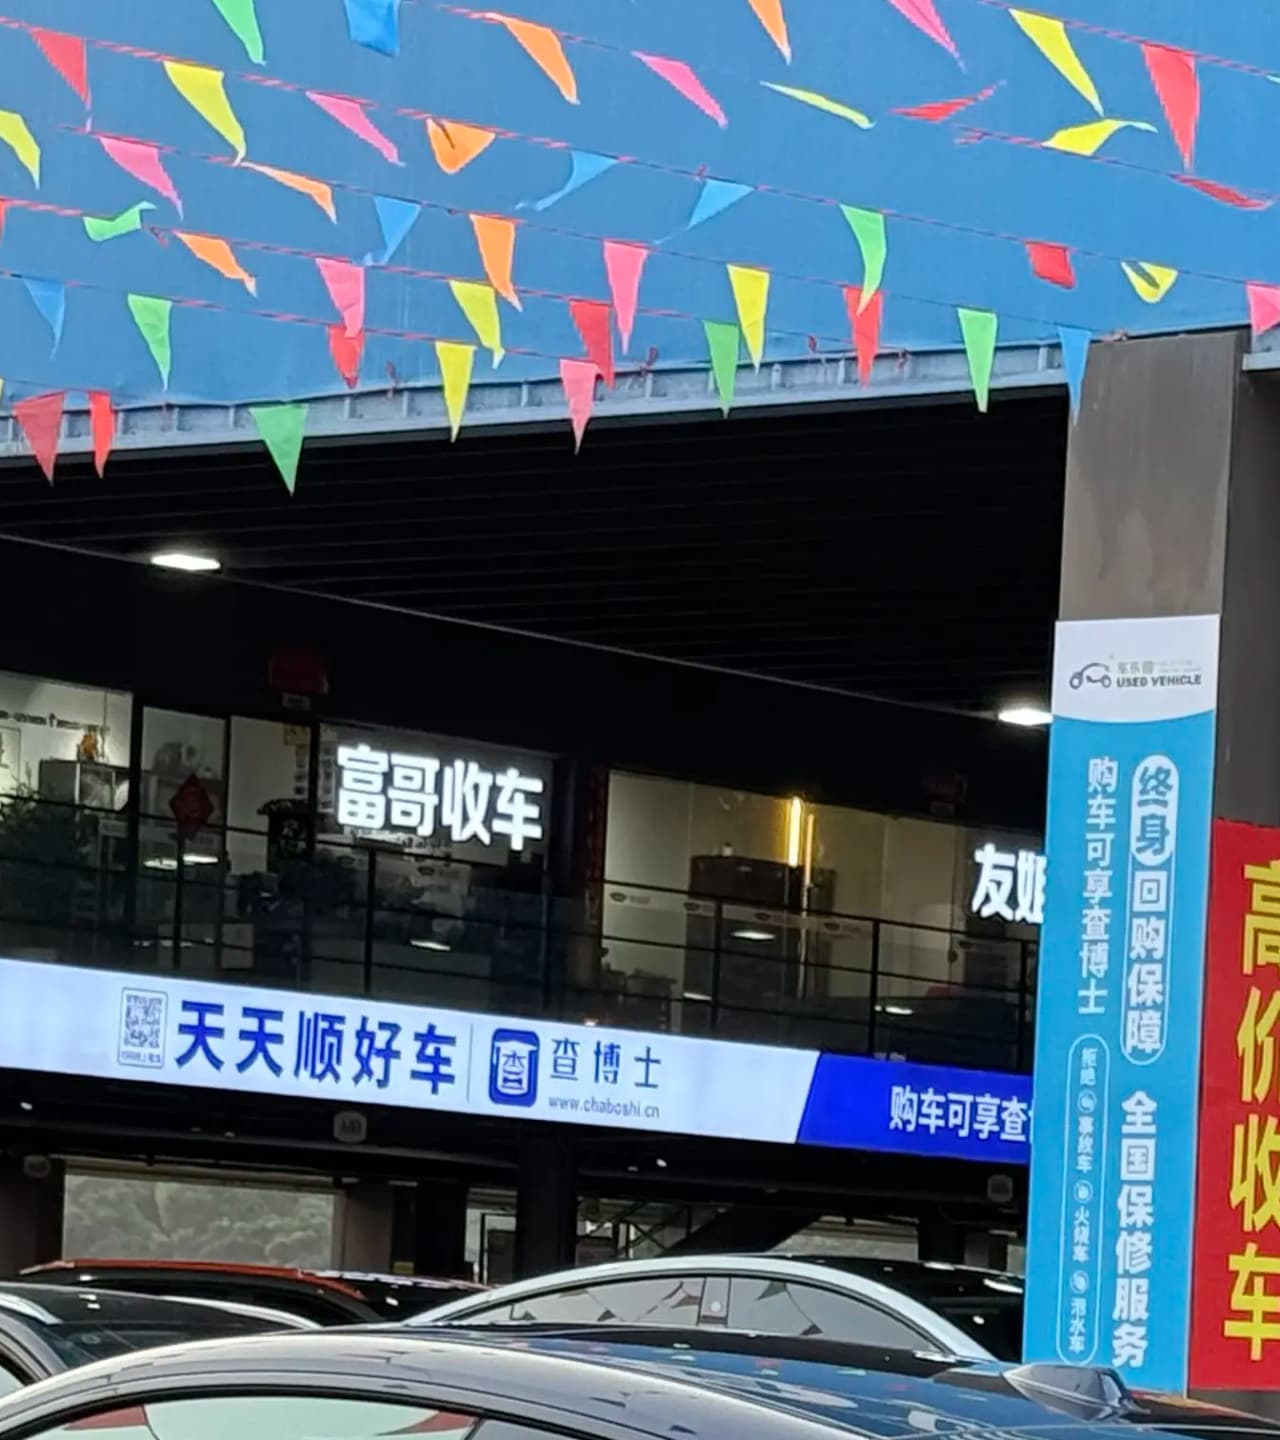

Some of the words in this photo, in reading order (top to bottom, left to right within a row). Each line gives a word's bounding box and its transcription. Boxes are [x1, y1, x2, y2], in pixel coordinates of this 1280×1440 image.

[1116, 676, 1149, 688] USED
[1151, 674, 1202, 687] VEHICLE
[336, 743, 544, 852] 富哥收车
[1077, 756, 1119, 1015] 购车可享查博士
[174, 999, 457, 1095] 天天顺好车
[549, 1036, 662, 1089] 查博士
[548, 1096, 660, 1119] www.chaboshi.cn
[889, 1084, 1034, 1145] 购车可享查
[1111, 1089, 1158, 1368] 全国保修服务
